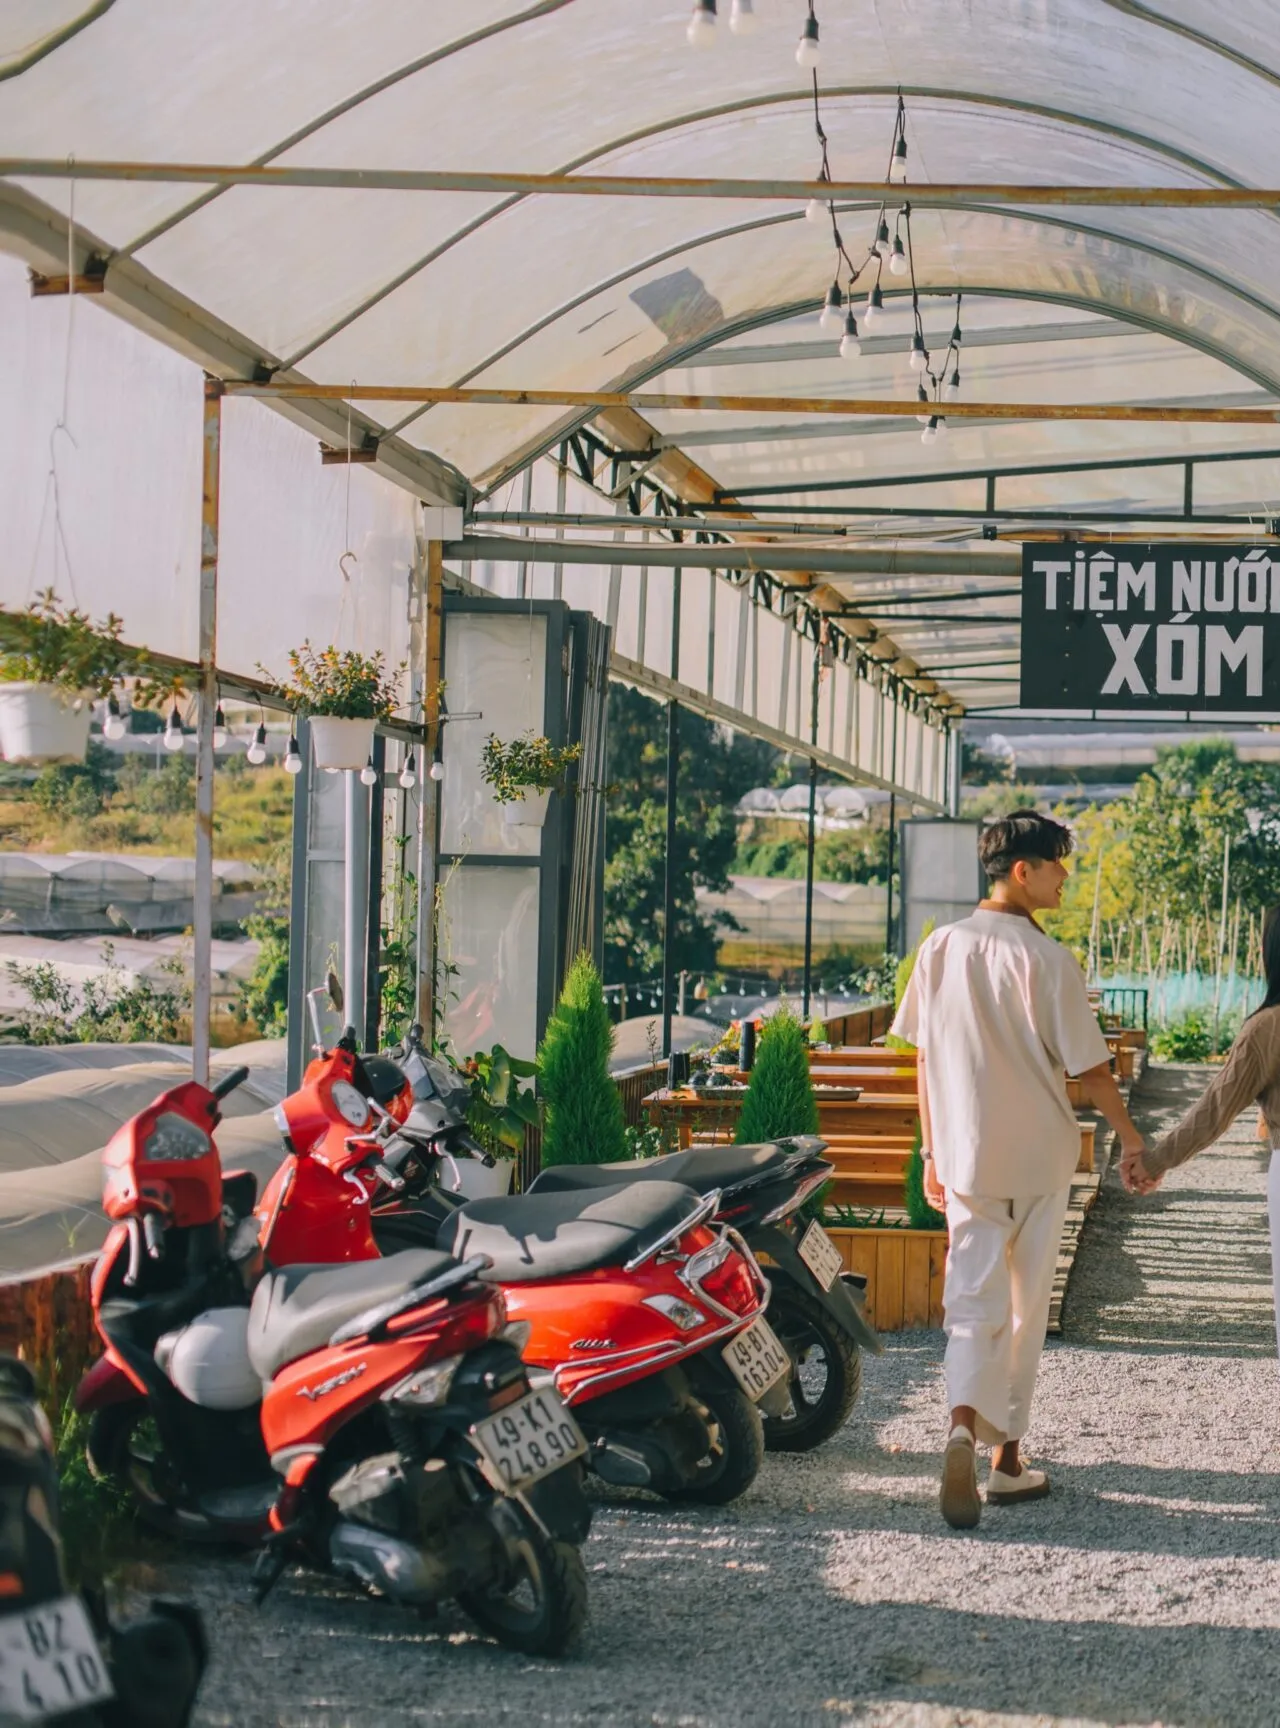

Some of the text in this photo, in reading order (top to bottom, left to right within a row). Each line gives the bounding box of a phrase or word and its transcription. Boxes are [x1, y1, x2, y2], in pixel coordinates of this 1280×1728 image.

[1101, 612, 1264, 697] XÓM
[731, 1324, 768, 1367] 49-B1
[491, 1396, 554, 1449] 49-K1
